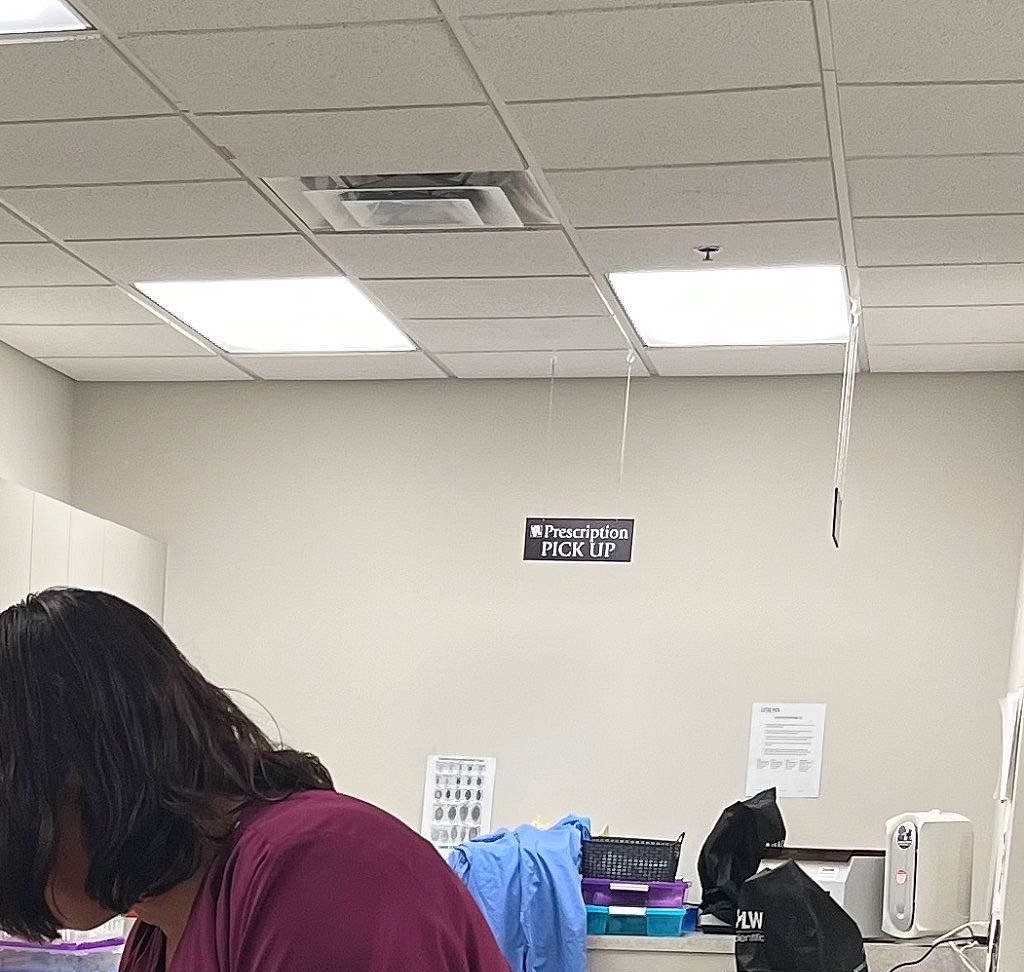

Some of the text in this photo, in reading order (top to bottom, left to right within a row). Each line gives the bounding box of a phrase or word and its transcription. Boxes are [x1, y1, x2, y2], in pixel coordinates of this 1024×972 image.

[544, 524, 628, 542] Prescription
[541, 541, 616, 558] PICK UP
